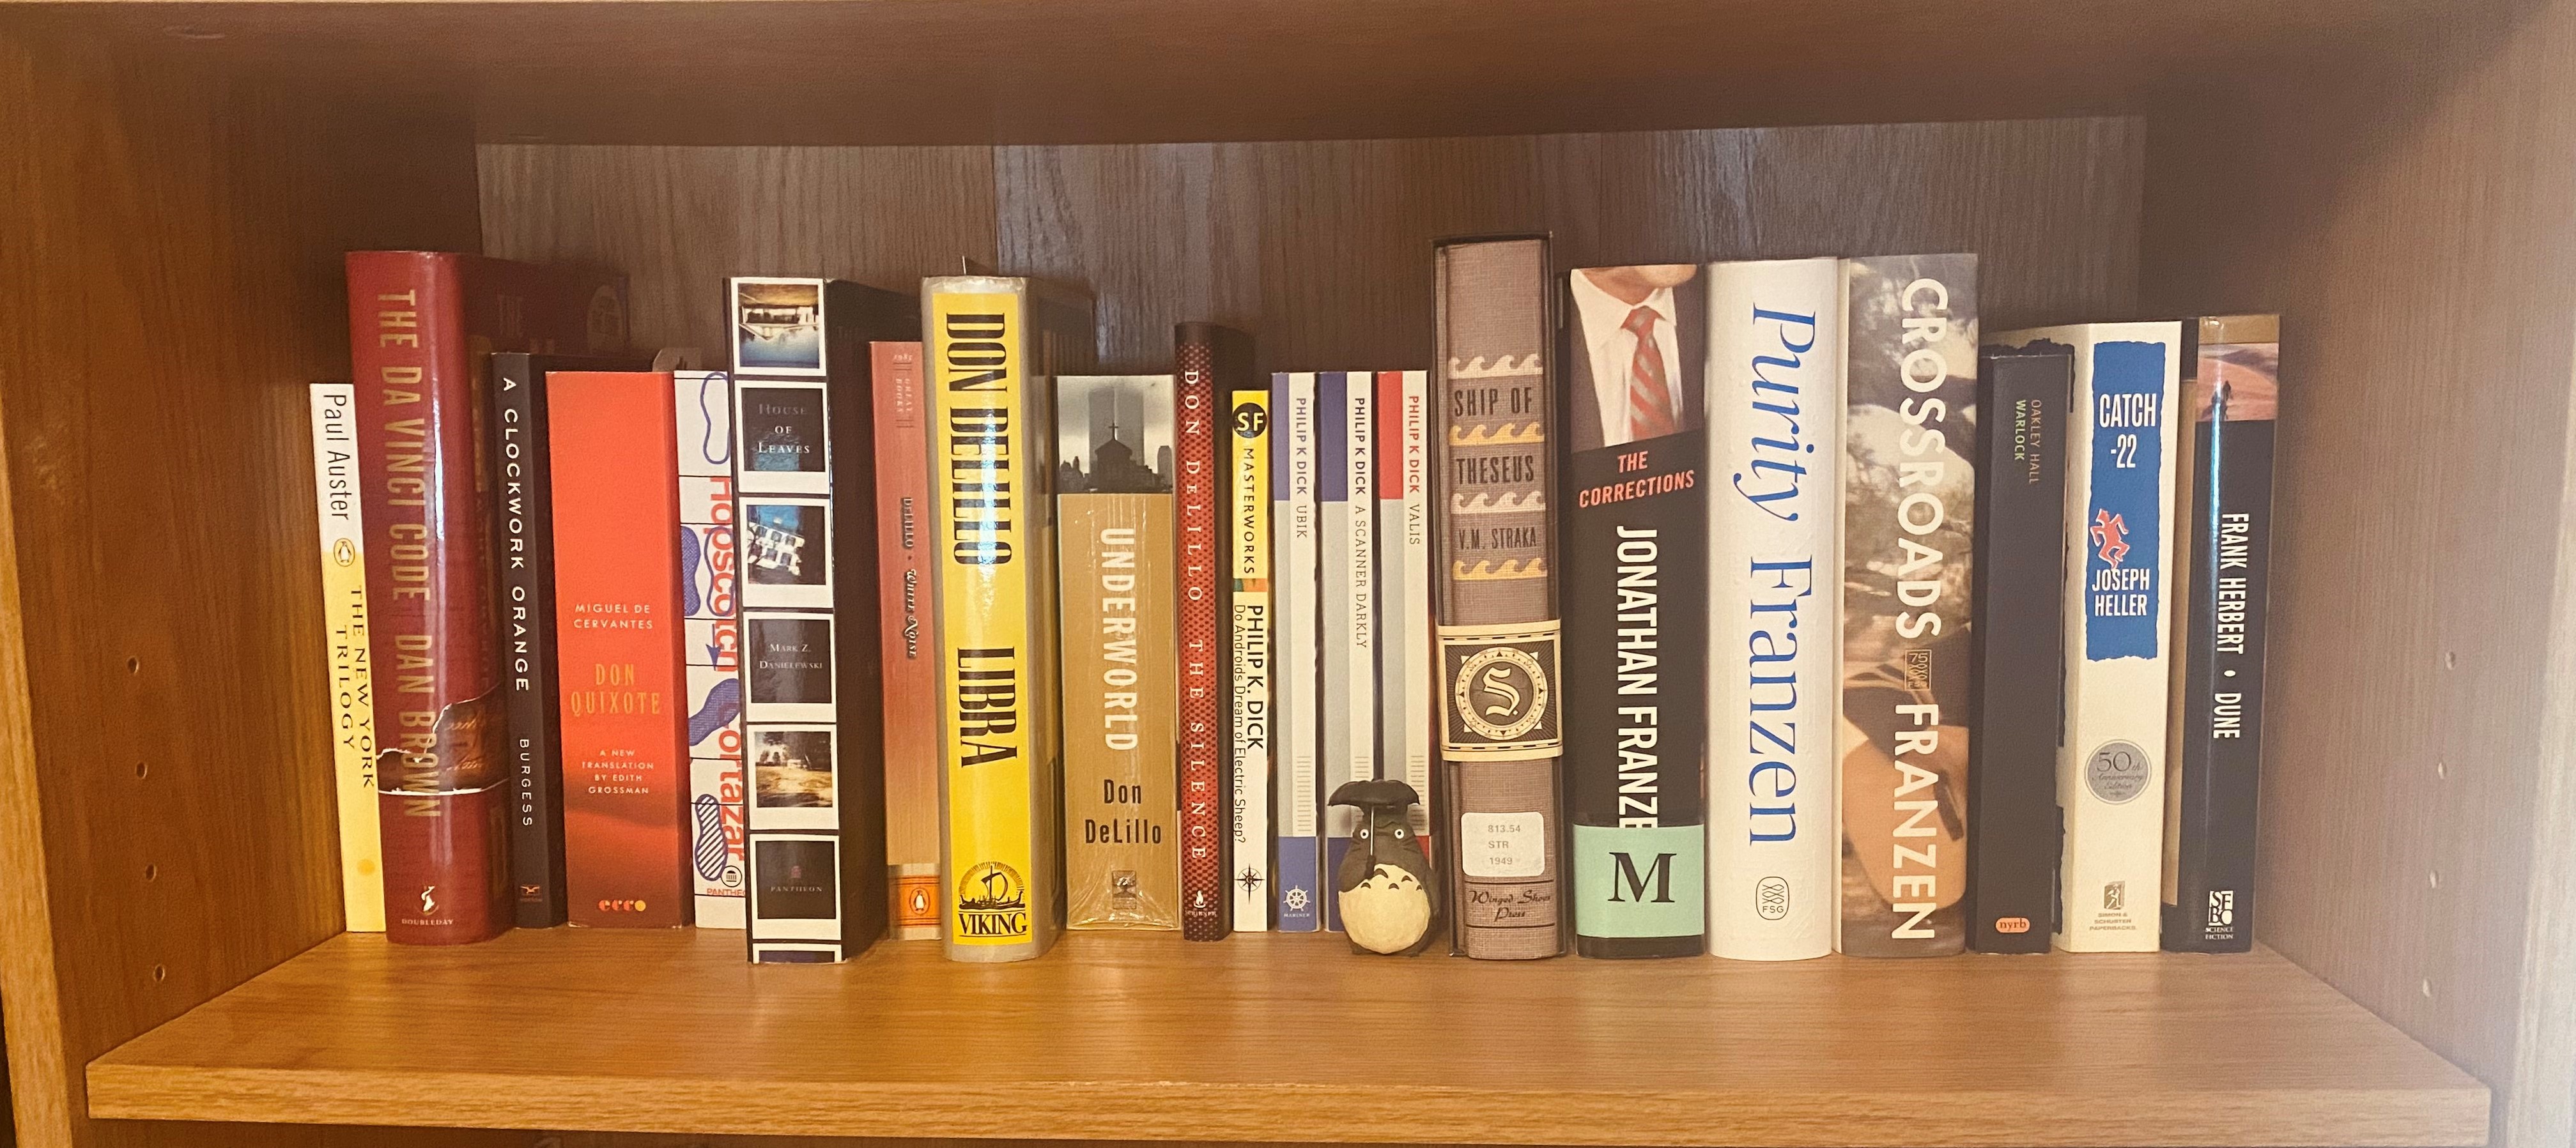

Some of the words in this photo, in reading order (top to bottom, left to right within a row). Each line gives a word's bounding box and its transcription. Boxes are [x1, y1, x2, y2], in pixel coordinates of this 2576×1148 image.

[378, 289, 419, 348] THE
[946, 313, 1008, 393] DON
[381, 367, 422, 406] DA
[503, 378, 516, 392] A
[1185, 370, 1201, 436] DON
[1454, 388, 1498, 417] SHIP
[1511, 387, 1531, 414] OF
[323, 395, 350, 441] Paul
[758, 404, 806, 415] HOUSE
[775, 425, 792, 434] OF
[1237, 412, 1265, 431] SF
[1296, 397, 1306, 443] PHILIP
[1355, 397, 1365, 443] PHILIP
[1408, 395, 1419, 440] PHILIP
[1733, 302, 1816, 521] Purity
[2014, 399, 2026, 461] WARLOCK
[2030, 399, 2042, 448] OAKLEY
[2099, 393, 2157, 428] CATCH
[385, 418, 426, 506] VINCI
[758, 442, 810, 454] LEAVES
[1617, 450, 1648, 473] THE
[1895, 278, 1948, 639] CROSSROADS
[2029, 454, 2040, 484] HALL
[2110, 434, 2137, 468] -22
[328, 452, 352, 521] Auster
[504, 408, 525, 569] CLOCKWORK
[950, 406, 1012, 565] DELILLO
[1296, 461, 1307, 495] DICK
[1355, 461, 1366, 495] DICK
[1409, 459, 1419, 493] DICK
[1456, 455, 1534, 485] THESEUS
[1579, 470, 1695, 509] CORRECTIONS
[1186, 460, 1203, 601] DELILLO
[1244, 448, 1254, 574] MASTERWORKS
[1296, 505, 1307, 538] UBIK
[1355, 506, 1366, 514] A
[1409, 503, 1420, 545] VALIS
[1355, 520, 1366, 587] SCANNER
[1459, 528, 1485, 551] V.M.
[1492, 526, 1537, 549] STRAKA
[2220, 513, 2249, 569] FRANK
[389, 523, 430, 601] CODE
[2092, 568, 2150, 592] JOSEPH
[351, 586, 365, 637] THE
[573, 618, 653, 629] CERVANTES
[575, 604, 628, 613] MIGUEL
[635, 604, 651, 613] DE
[1233, 604, 1246, 622] Do
[1356, 593, 1367, 648] DARKLY
[1617, 525, 1658, 696] JONATHAN
[2095, 594, 2147, 616] HELLER
[2217, 578, 2246, 654] HERBERT
[511, 586, 528, 691] ORANGE
[770, 643, 798, 653] MARK
[1100, 528, 1139, 751] UNDERWORLD
[1233, 625, 1246, 682] Androids
[1247, 605, 1263, 668] PHILIP
[1909, 653, 1928, 662] 75
[354, 648, 369, 707] NEW
[395, 634, 435, 693] DAN
[595, 663, 635, 685] DON
[759, 661, 822, 670] DANIELEWSKI
[1189, 639, 1204, 700] THE
[1247, 675, 1263, 695] K.
[335, 625, 355, 749] TRILOGY
[571, 691, 661, 717] QUIXOTE
[958, 647, 1018, 768] LIBRA
[1234, 685, 1246, 728] Dream
[1748, 555, 1813, 847] Franzen
[1247, 701, 1263, 749] DICK
[2213, 693, 2242, 739] DUNE
[360, 718, 374, 788] YORK
[1235, 732, 1246, 744] of
[399, 711, 442, 817] BROWN
[519, 739, 532, 827] BURGESS
[594, 774, 607, 782] BY
[612, 774, 642, 782] EDITH
[1235, 747, 1246, 795] Electric
[589, 786, 649, 795] GROSSMAN
[1104, 779, 1142, 804] Don
[1191, 722, 1206, 859] SILENCE
[1085, 818, 1162, 845] DeLillo
[1235, 799, 1246, 843] Sheep?
[1488, 824, 1521, 833] 813.54
[1891, 704, 1940, 939] FRANZEN
[1488, 841, 1509, 849] STR
[1489, 857, 1513, 865] 1949
[1469, 890, 1514, 905] Winged
[1608, 852, 1677, 903] M
[959, 912, 1027, 936] VIKING
[1495, 907, 1526, 922] Press
[1762, 905, 1784, 914] FSG
[1999, 918, 2027, 931] nyrb
